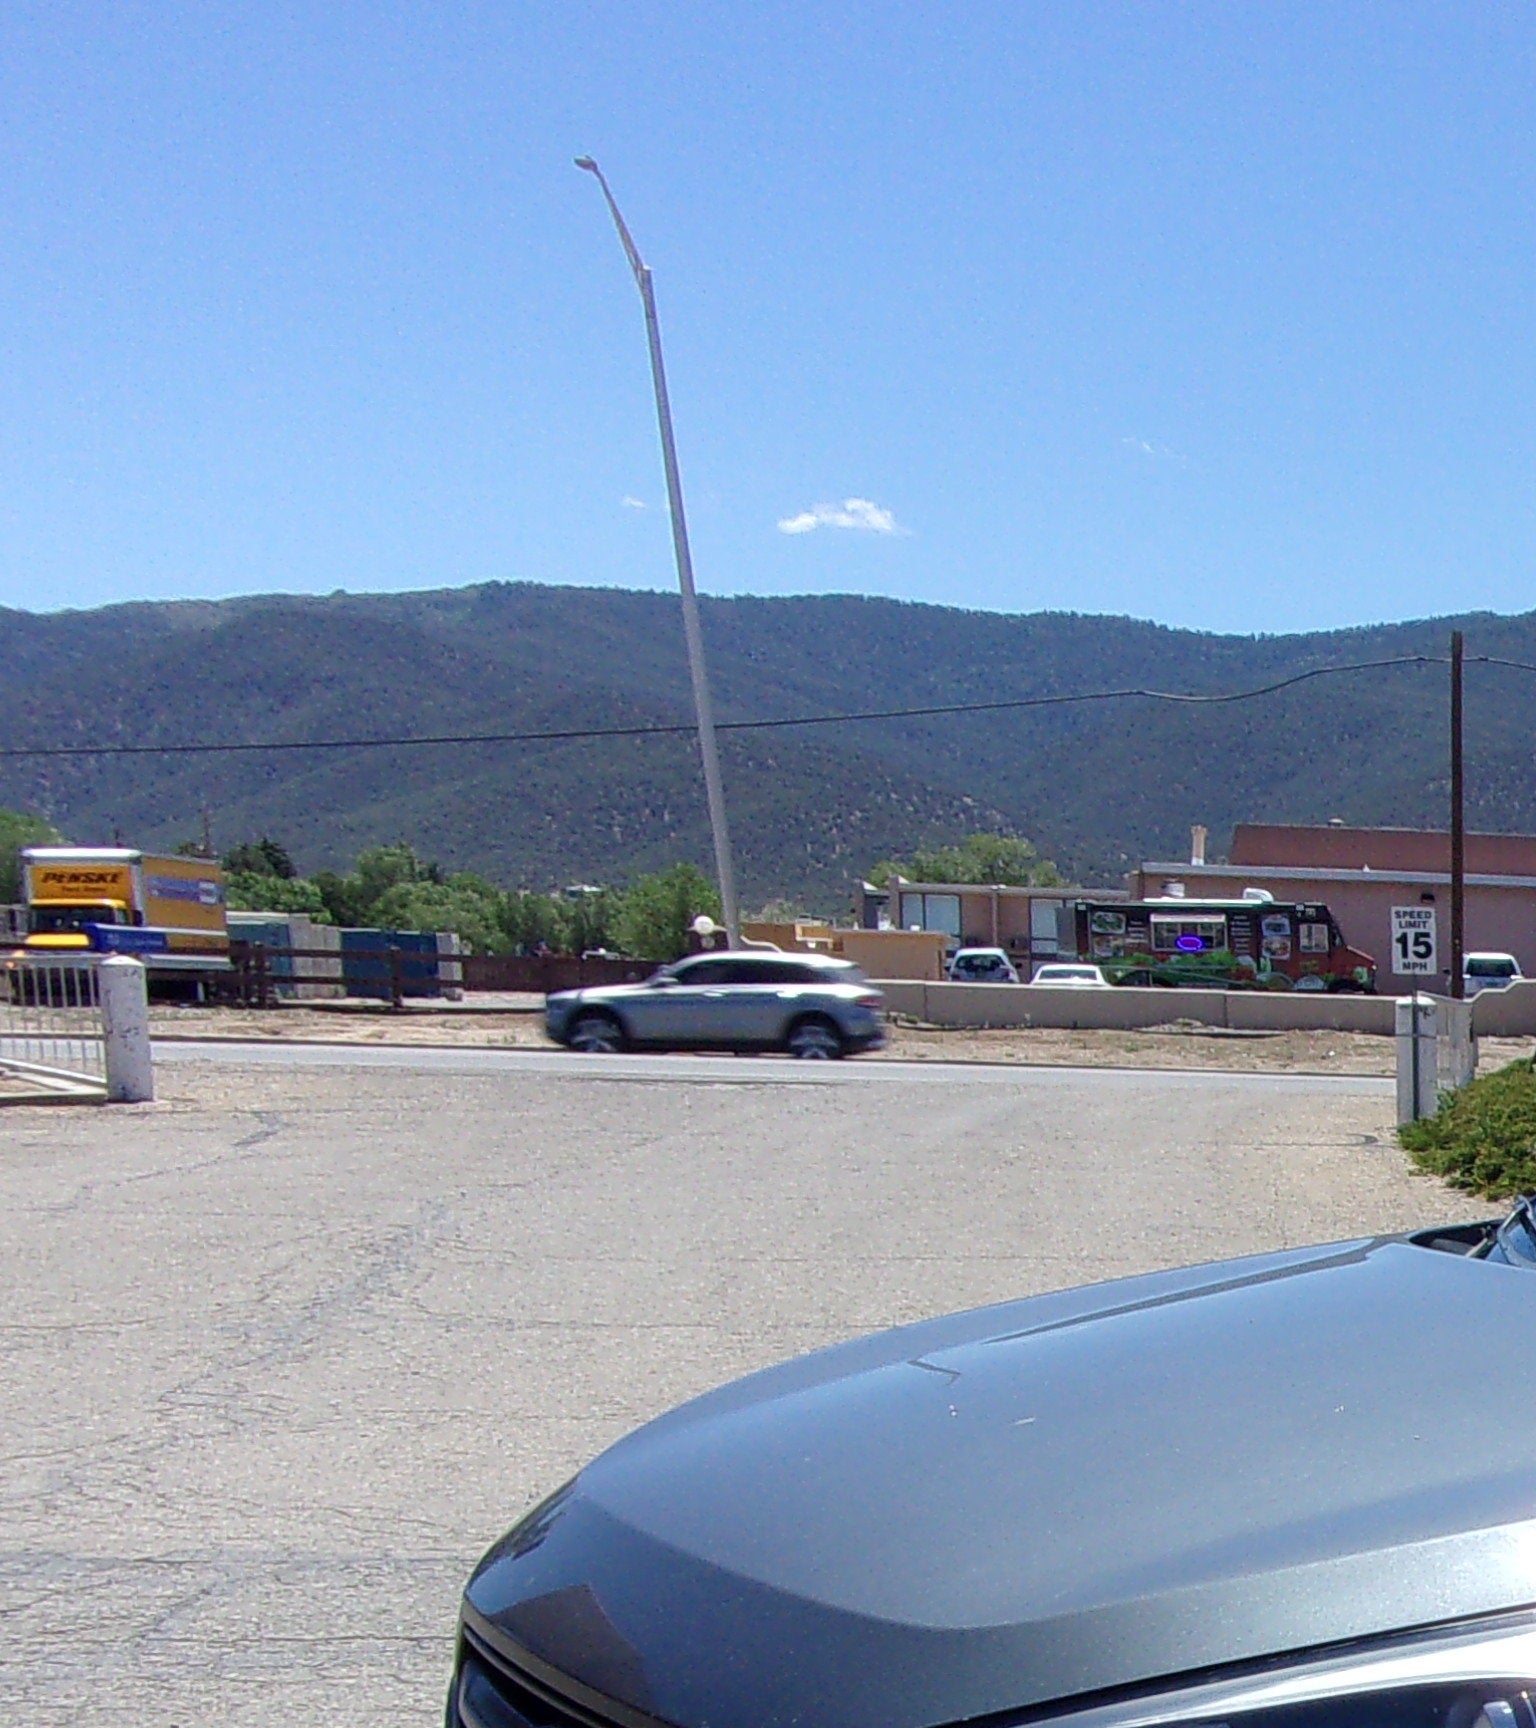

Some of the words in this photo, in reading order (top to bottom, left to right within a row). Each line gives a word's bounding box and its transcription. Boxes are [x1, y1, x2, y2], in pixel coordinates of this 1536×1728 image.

[41, 872, 122, 884] PENSKE
[1394, 910, 1432, 919] SPEED
[1398, 920, 1428, 929] LIMIT
[1395, 932, 1433, 959] 15
[1402, 962, 1427, 971] MPH
